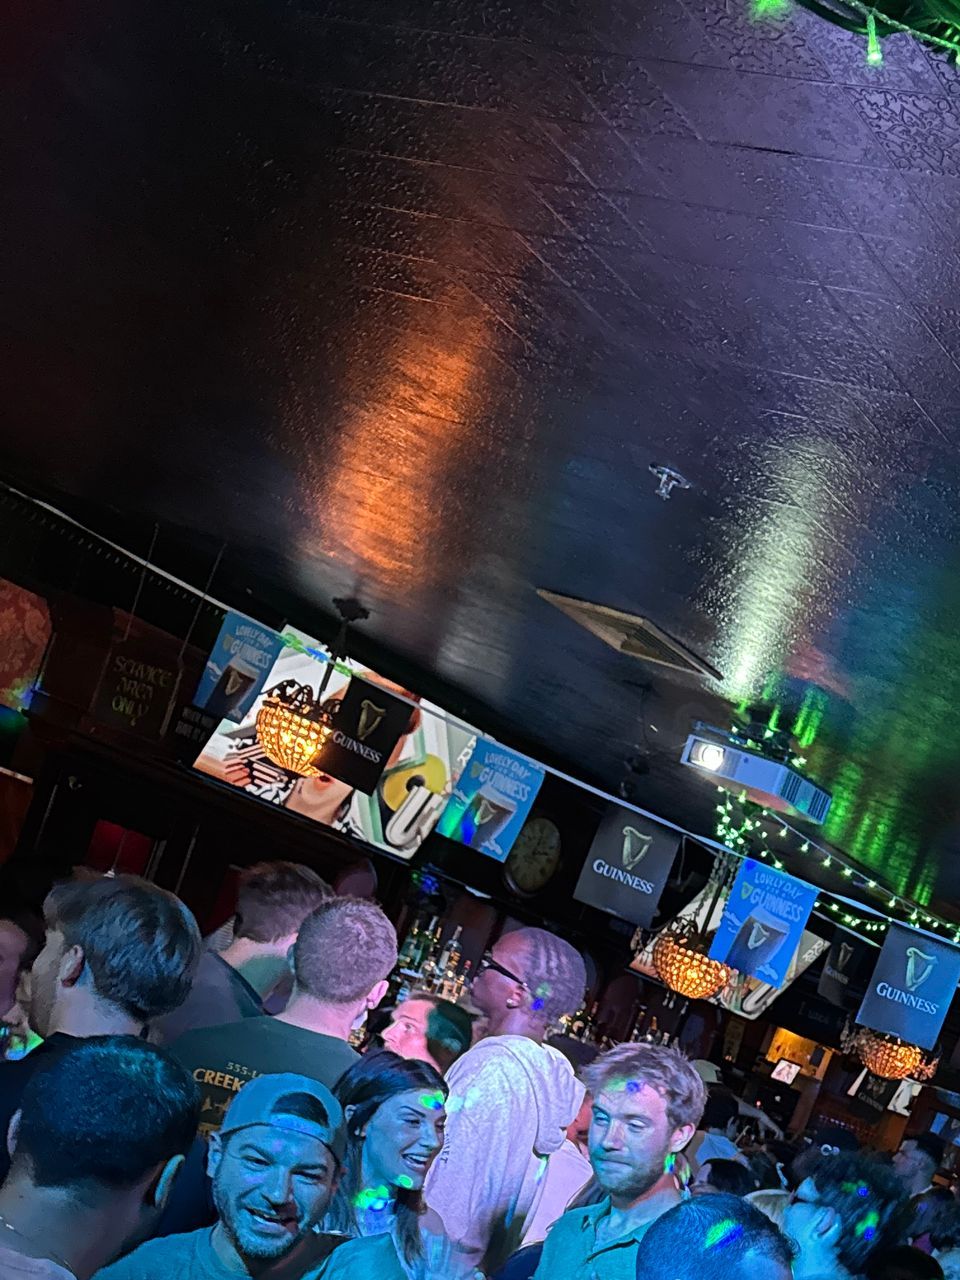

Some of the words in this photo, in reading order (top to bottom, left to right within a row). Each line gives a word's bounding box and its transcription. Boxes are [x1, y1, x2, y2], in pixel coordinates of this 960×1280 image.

[332, 730, 383, 763] GUINNESS
[479, 767, 531, 802] GUINNESS
[592, 858, 656, 895] GUINNESS
[754, 872, 784, 888] LOVELY
[782, 883, 804, 900] DAY
[750, 888, 804, 922] GUINNESS
[876, 981, 940, 1015] GUINNESS
